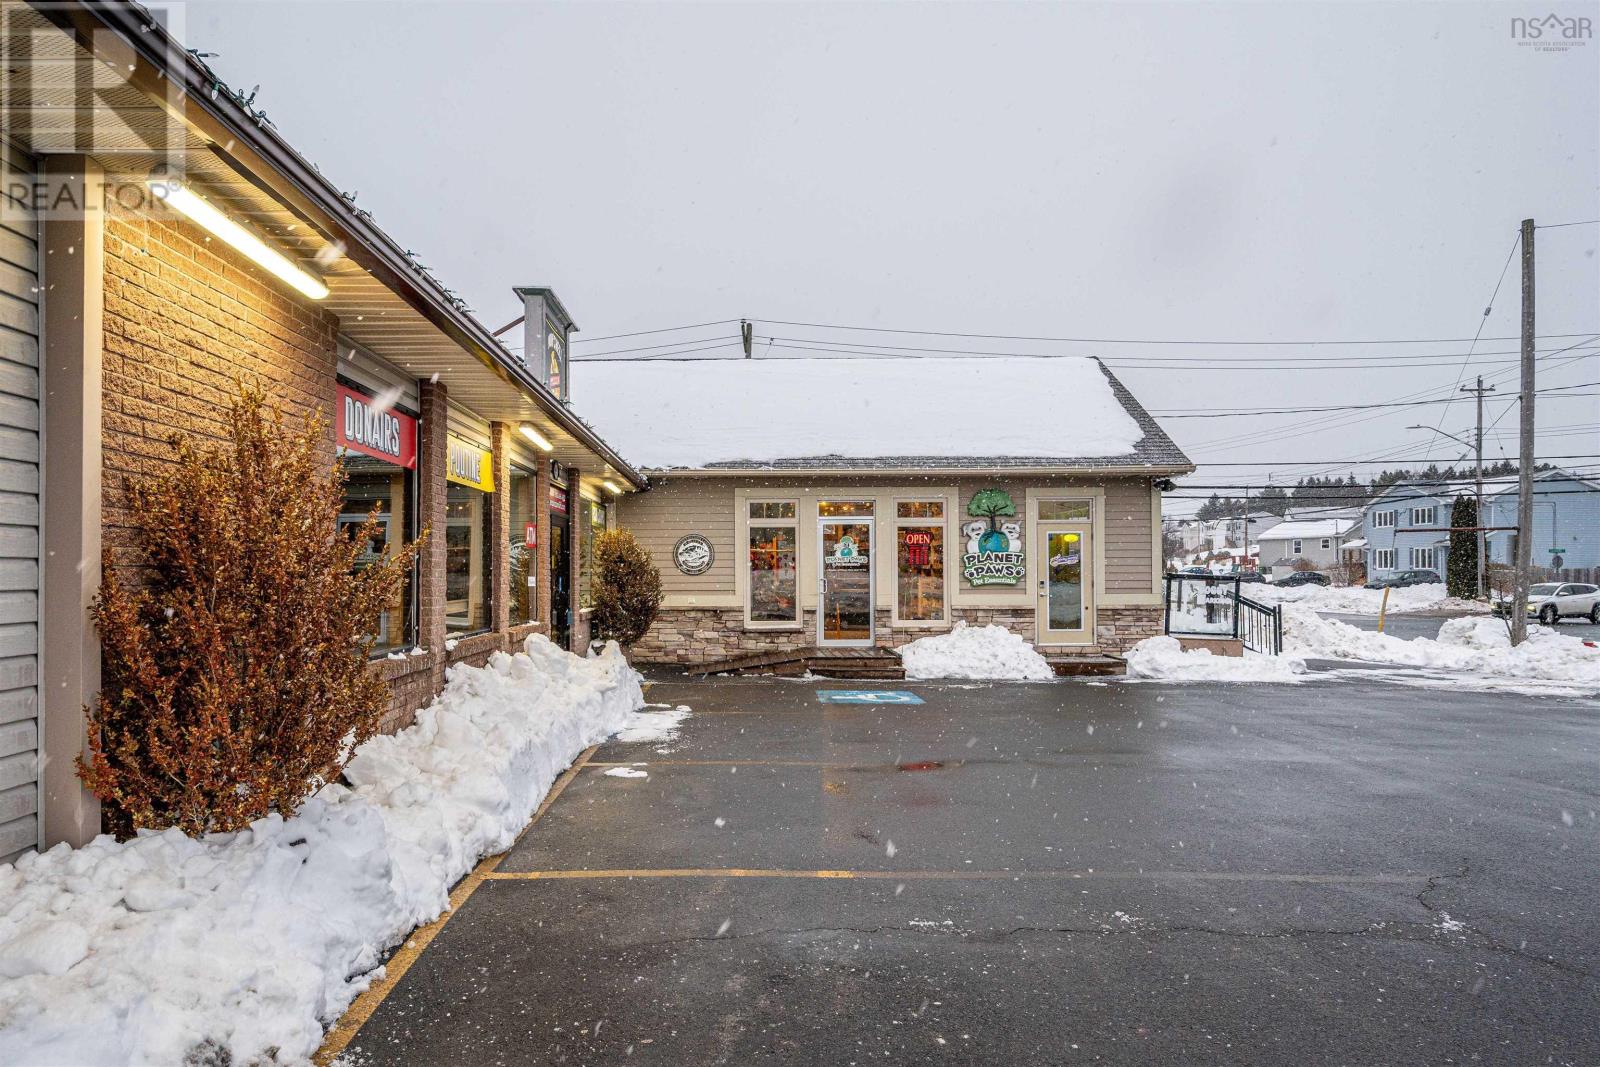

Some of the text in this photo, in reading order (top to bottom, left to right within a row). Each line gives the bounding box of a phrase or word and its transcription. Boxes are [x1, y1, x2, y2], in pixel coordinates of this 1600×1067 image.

[343, 393, 401, 458] DONAIRS
[449, 439, 481, 485] POUTINE
[906, 533, 930, 545] OPEN
[964, 551, 1024, 566] PLANET
[973, 563, 1015, 578] PAWS
[984, 577, 1017, 585] Essentials
